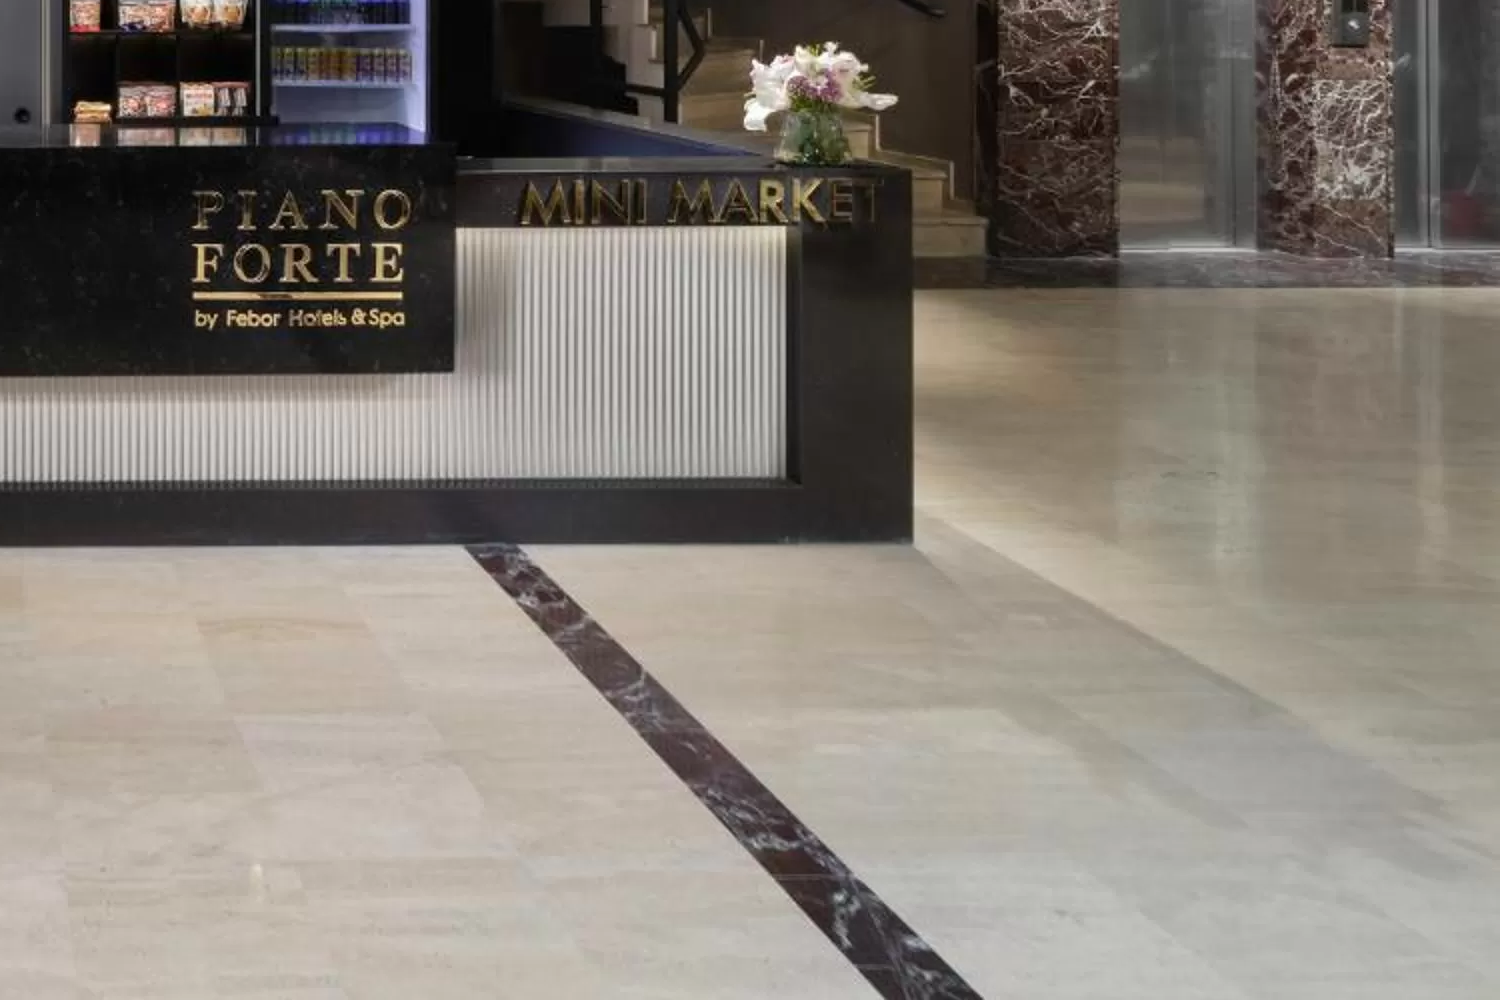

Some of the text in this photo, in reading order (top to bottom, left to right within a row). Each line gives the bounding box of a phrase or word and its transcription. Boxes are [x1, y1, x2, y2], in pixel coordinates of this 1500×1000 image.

[191, 189, 412, 231] PIANO
[520, 176, 885, 225] MINI MARKET
[191, 243, 405, 283] FORTE
[195, 310, 218, 330] by
[226, 309, 281, 327] Febor
[288, 308, 347, 326] Hotels
